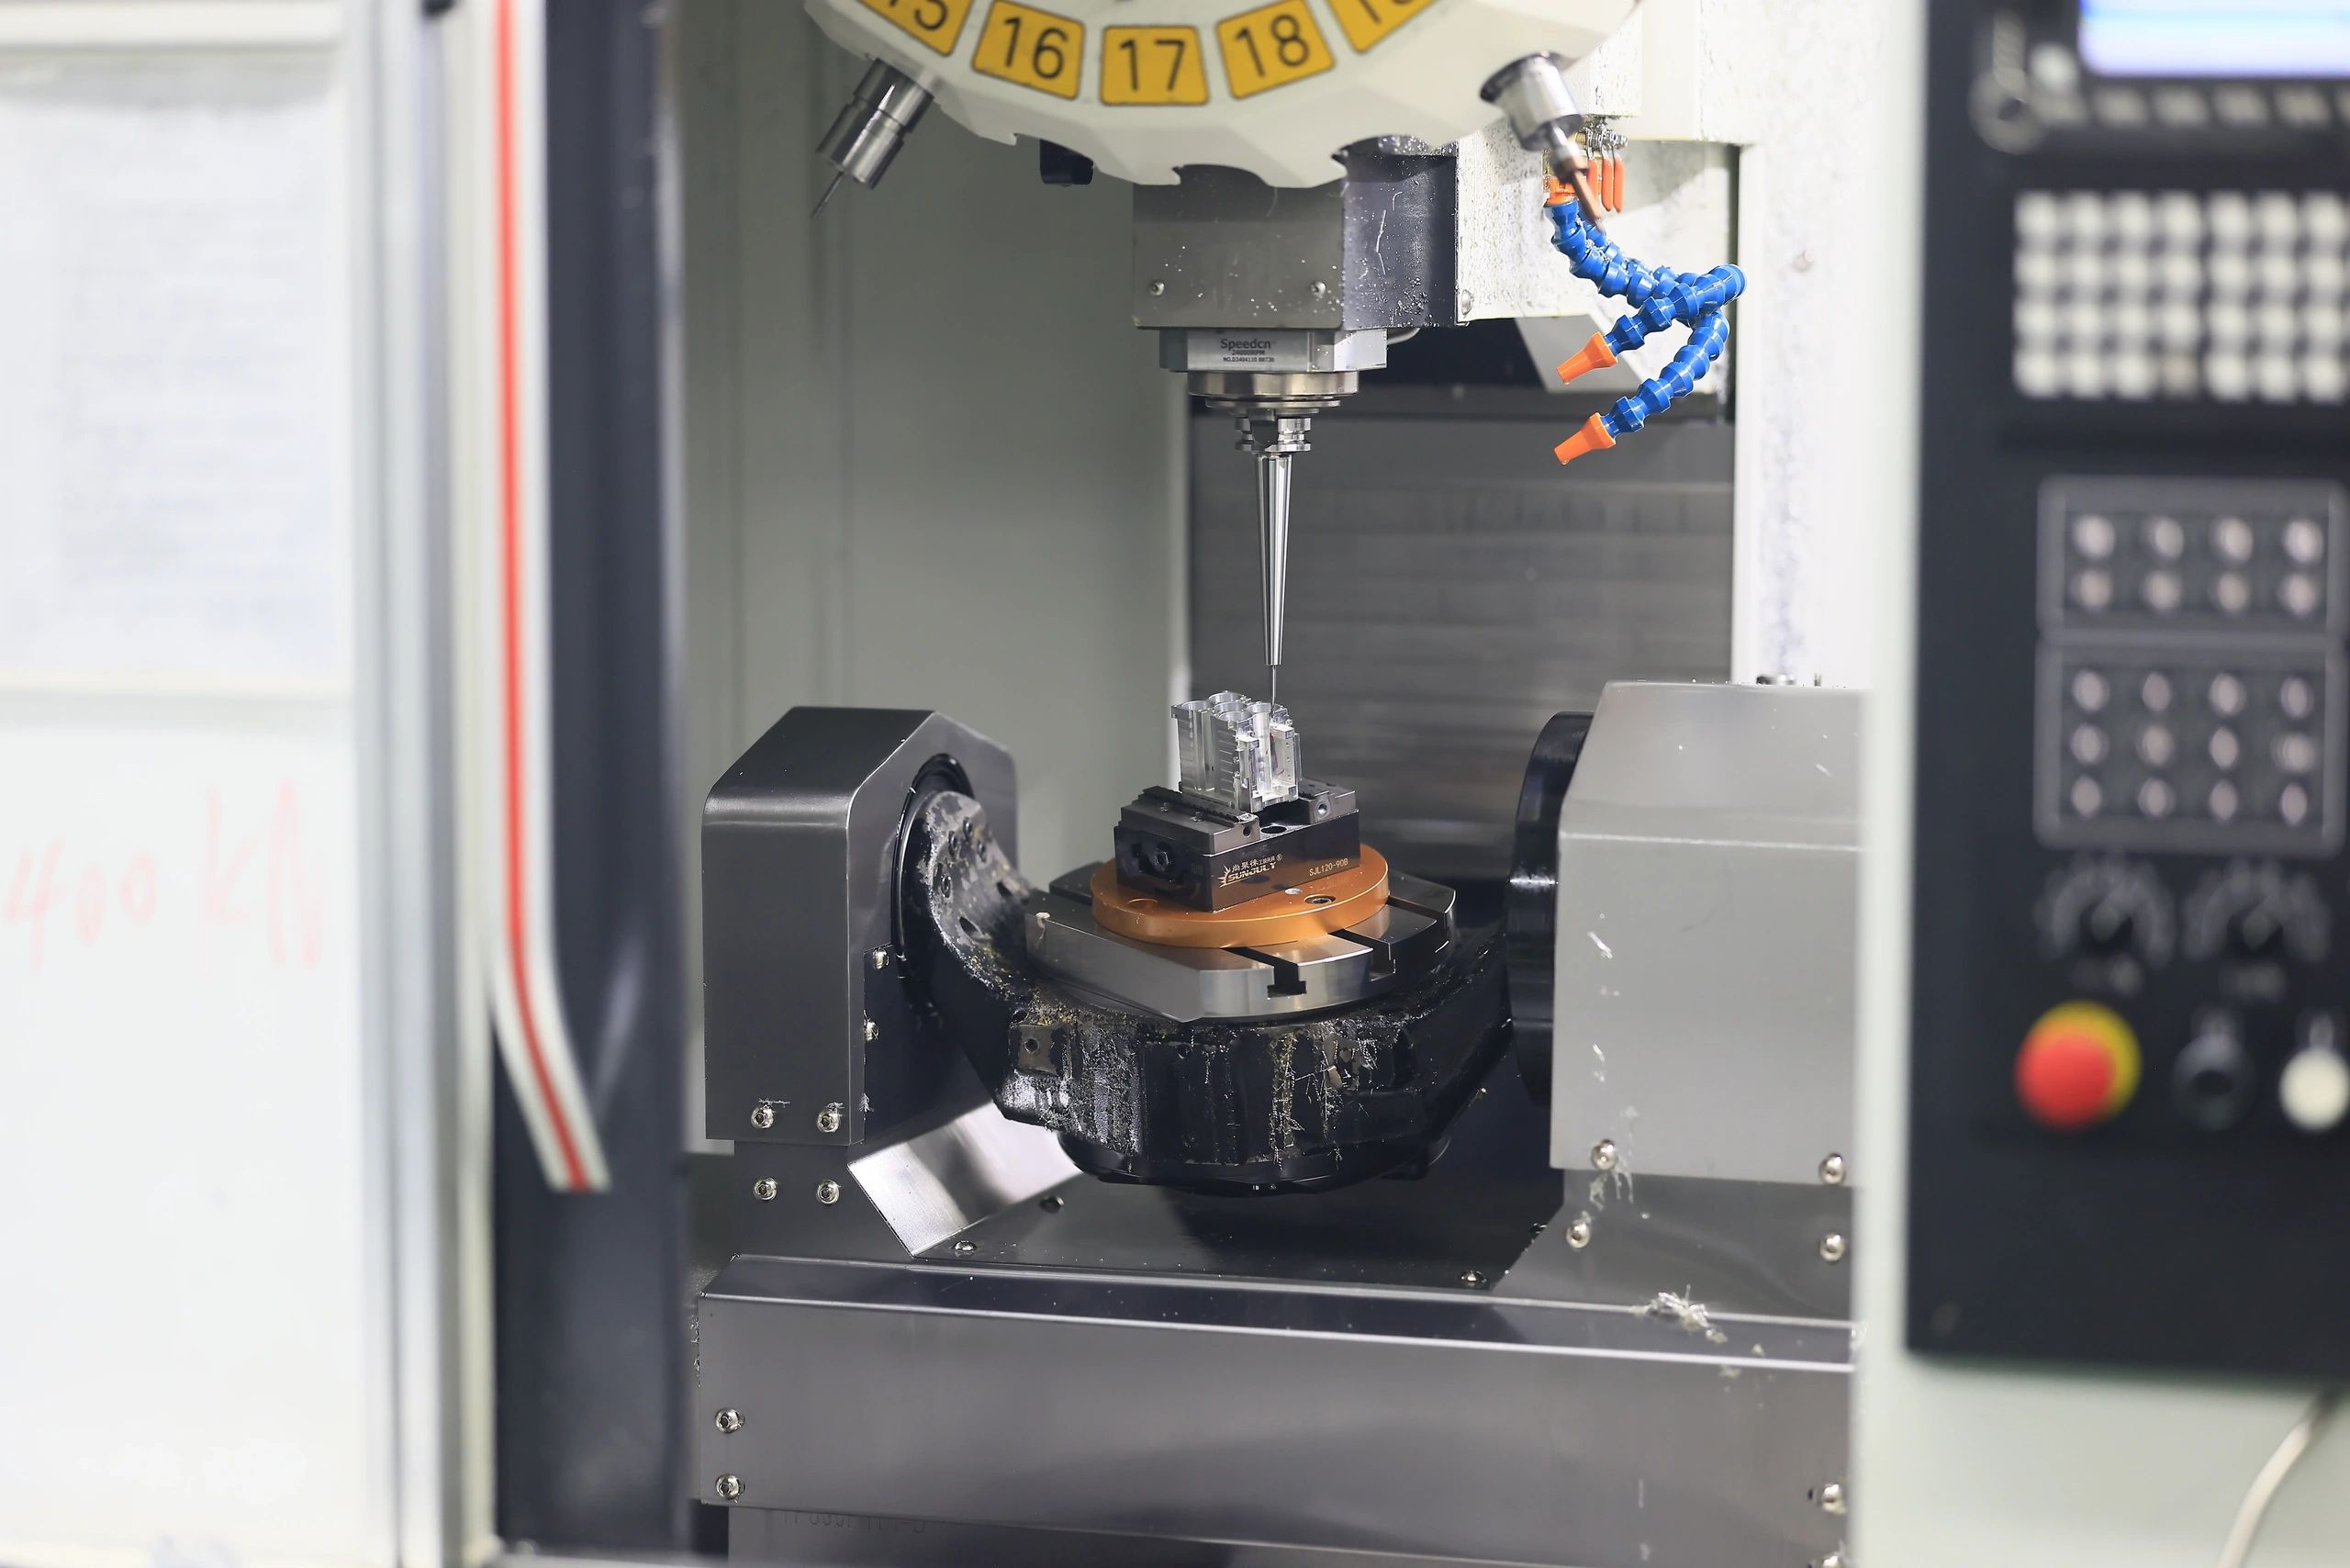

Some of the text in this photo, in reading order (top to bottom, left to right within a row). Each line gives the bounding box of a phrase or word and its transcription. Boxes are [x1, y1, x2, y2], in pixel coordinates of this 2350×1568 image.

[1002, 16, 1069, 81] 16
[1118, 38, 1186, 93] 17
[1233, 14, 1310, 79] 18
[1220, 339, 1270, 351] Speedcn
[1309, 857, 1348, 877] SJL120-90B
